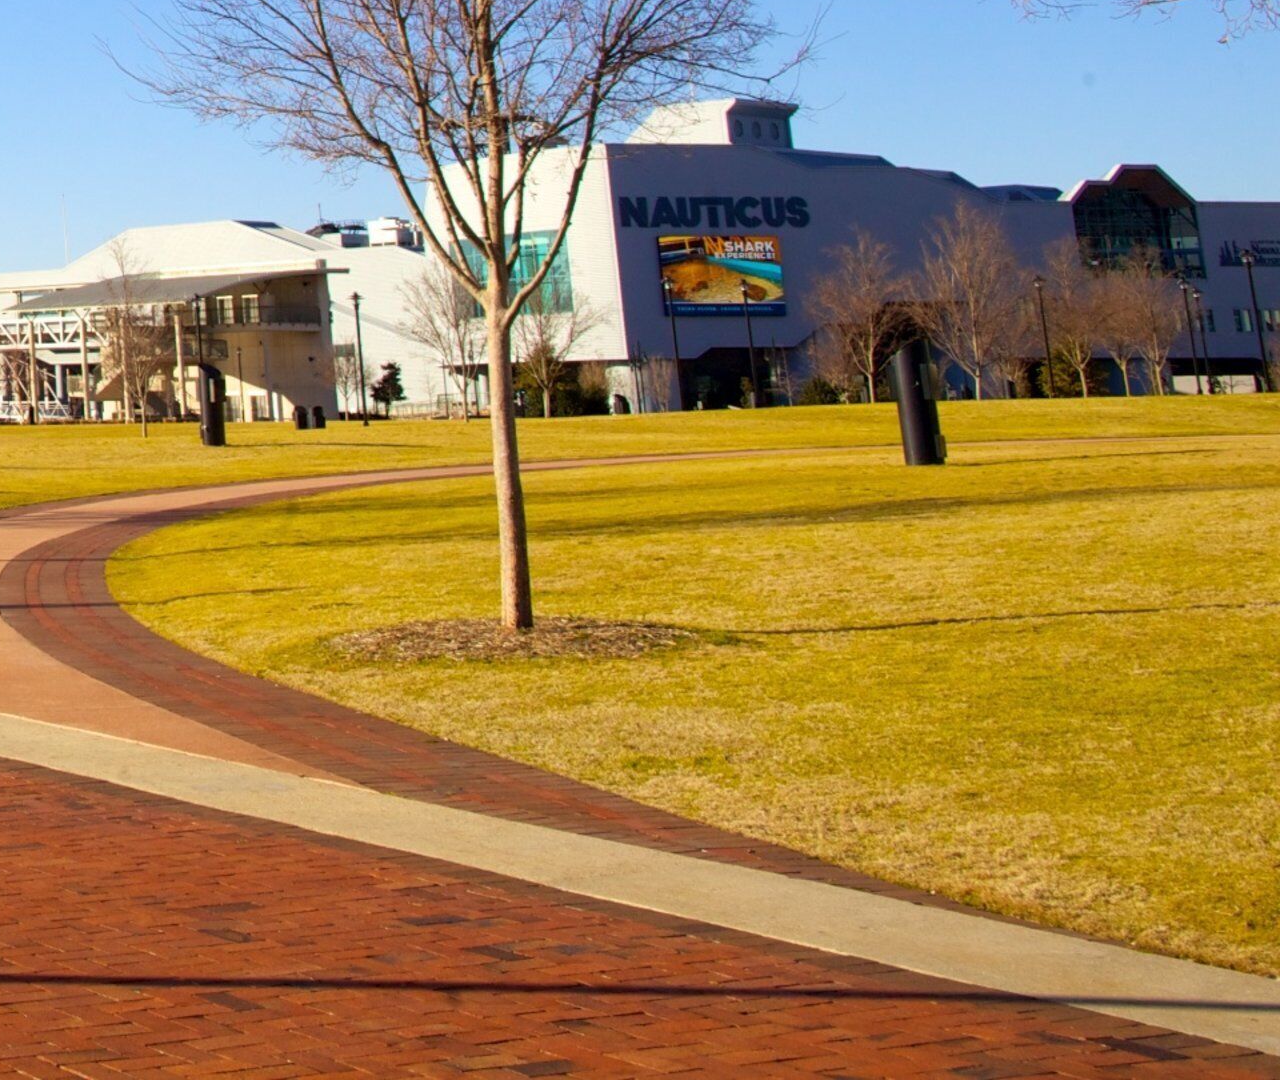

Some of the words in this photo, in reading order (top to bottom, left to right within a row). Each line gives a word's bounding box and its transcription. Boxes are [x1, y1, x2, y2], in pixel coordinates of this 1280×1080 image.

[618, 196, 811, 228] NAUTICUS
[724, 241, 775, 252] SHARK
[714, 252, 776, 260] EXPERIENCE!
